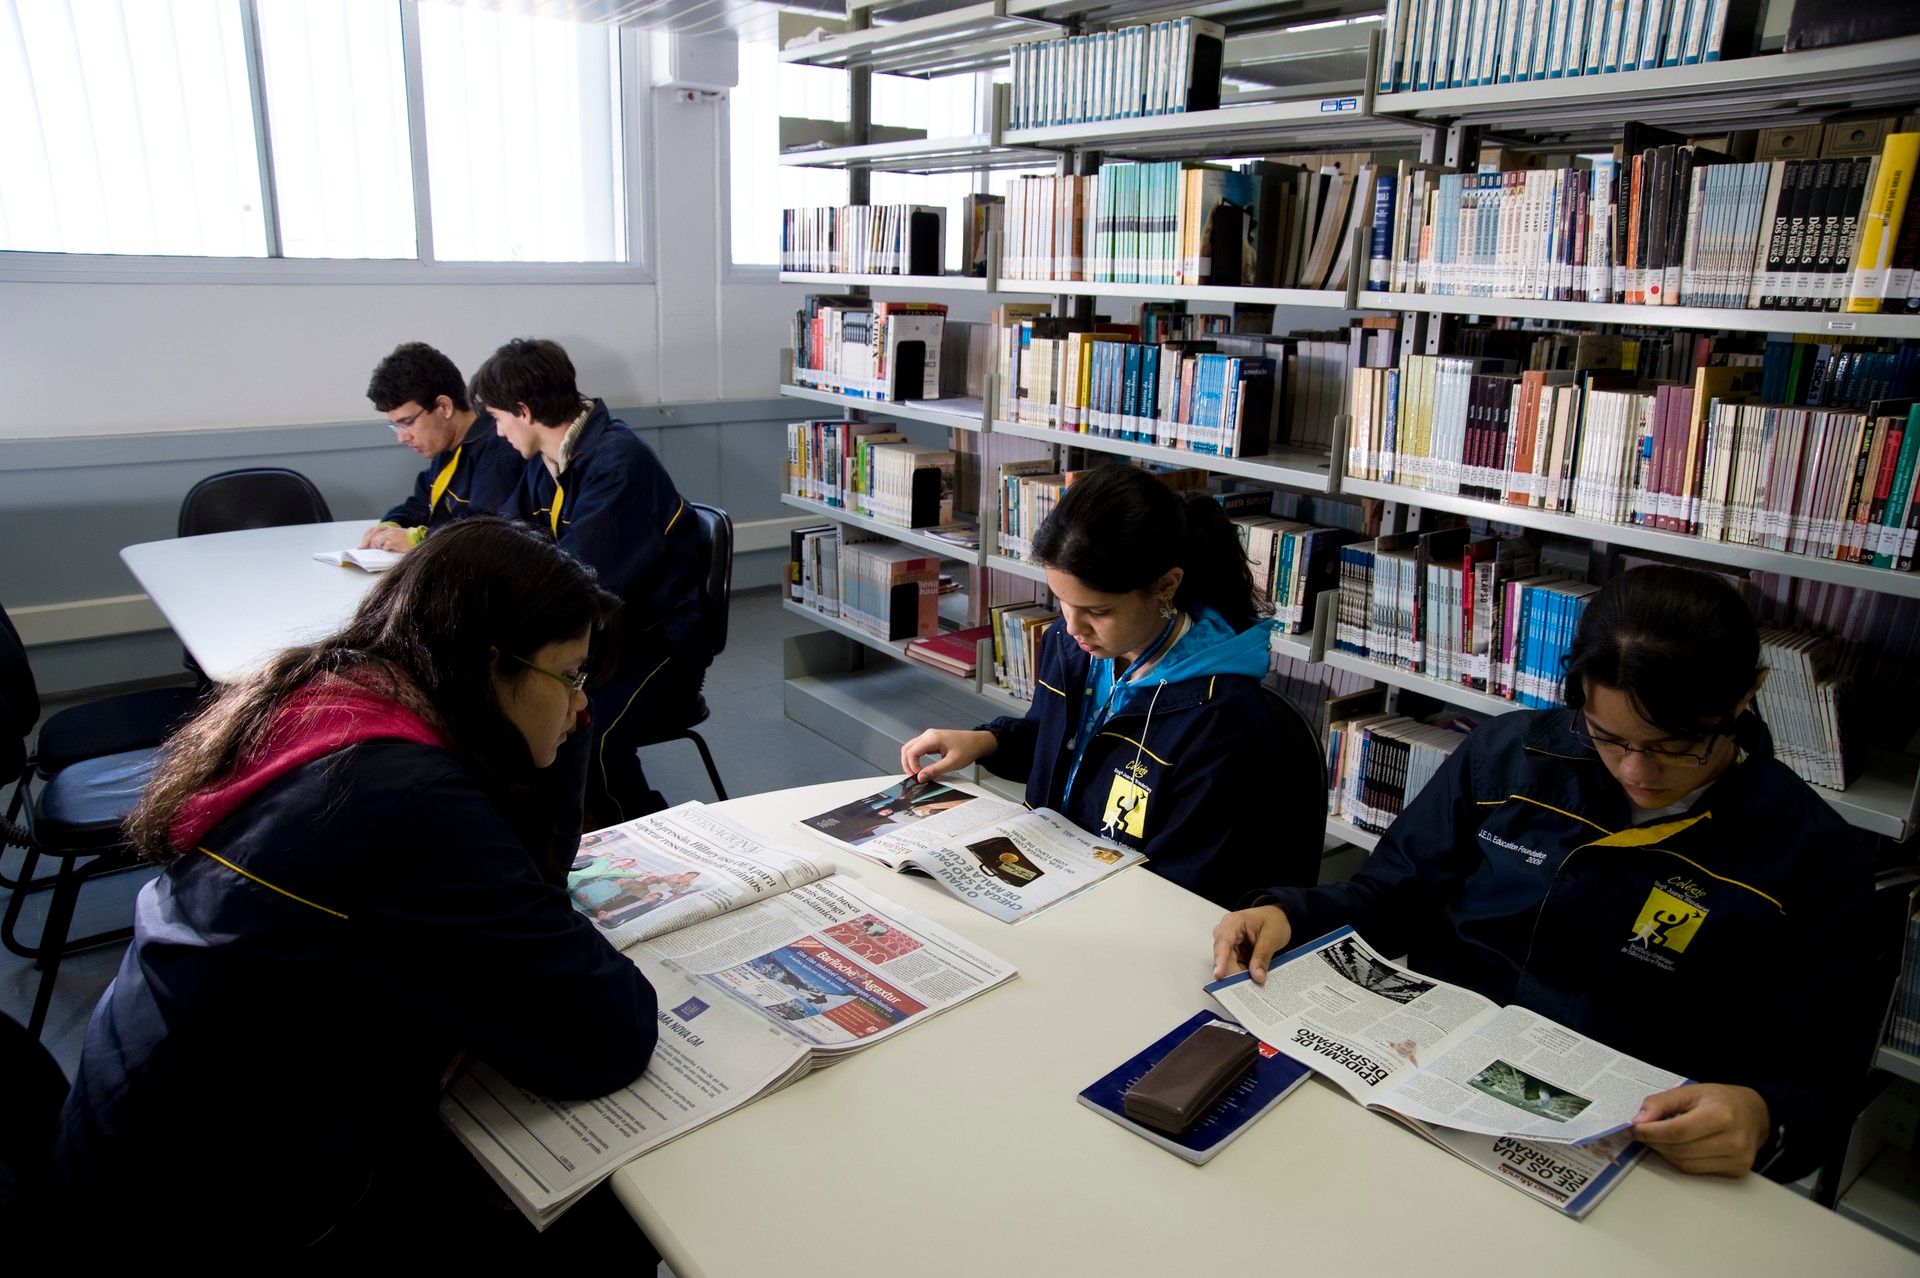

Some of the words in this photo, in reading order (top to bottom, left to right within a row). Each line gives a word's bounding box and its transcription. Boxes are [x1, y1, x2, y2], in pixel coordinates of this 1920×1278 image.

[1598, 170, 1607, 199] DEPOIS
[1774, 217, 1787, 234] DOS
[1791, 217, 1803, 234] DOS
[1808, 216, 1820, 234] DOS
[1826, 216, 1838, 233] DOS
[1843, 216, 1855, 233] DOS
[1769, 235, 1781, 263] DEUSES
[1778, 229, 1787, 256] ALIMENTO
[1785, 236, 1797, 264] DEUSES
[1793, 231, 1803, 257] ALIMENTO
[1802, 235, 1814, 263] DEUSES
[1810, 230, 1820, 256] ALIMENTO
[1819, 235, 1831, 263] DEUSES
[1828, 230, 1837, 256] ALIMENTO
[1837, 235, 1848, 263] DEUSES
[1845, 230, 1854, 256] ALIMENTO
[1809, 359, 1824, 392] FÍSICA
[1123, 385, 1131, 410] História
[1480, 568, 1488, 603] COLAPSO
[1011, 836, 1027, 848] COM
[1024, 840, 1036, 848] DE
[1025, 846, 1047, 862] CHEGA
[1033, 846, 1053, 859] TUDO
[1491, 835, 1519, 851] Education
[1517, 844, 1547, 860] Foundation
[690, 839, 720, 859] Hillary
[747, 867, 778, 889] para
[940, 846, 967, 866] CUIA
[963, 863, 974, 873] E
[1051, 856, 1068, 867] COM
[1525, 855, 1543, 866] 2009
[724, 865, 765, 894] vizinhos
[935, 866, 969, 893] PIAUÍ
[950, 865, 976, 886] SÃO
[971, 869, 1006, 893] MALA
[975, 882, 986, 892] A
[1666, 873, 1707, 899] Colégio
[814, 892, 846, 917] diálogo
[834, 894, 861, 914] busca
[966, 889, 979, 899] O
[984, 889, 1023, 912] CHEGA
[1002, 888, 1021, 901] DE
[1666, 887, 1684, 899] Juarez
[1683, 895, 1710, 913] Wanderley
[801, 897, 840, 924] islâmicos
[1629, 942, 1652, 957] Instituto
[815, 949, 858, 978] Bariloche
[861, 977, 902, 1005] Agaxtur
[844, 981, 870, 1000] vantagens
[667, 1020, 691, 1039] NOVA
[685, 1033, 705, 1048] GM
[1289, 1033, 1314, 1048] DE
[1295, 1026, 1389, 1080] DESPREPARO
[1311, 1041, 1380, 1085] EPIDEMIA
[1490, 1141, 1526, 1166] EUA
[1495, 1134, 1588, 1186] ESPIRRAM
[1496, 1165, 1533, 1187] Mundo
[1525, 1160, 1554, 1181] OS
[1532, 1183, 1567, 1203] Nosso
[1551, 1175, 1581, 1193] SE
